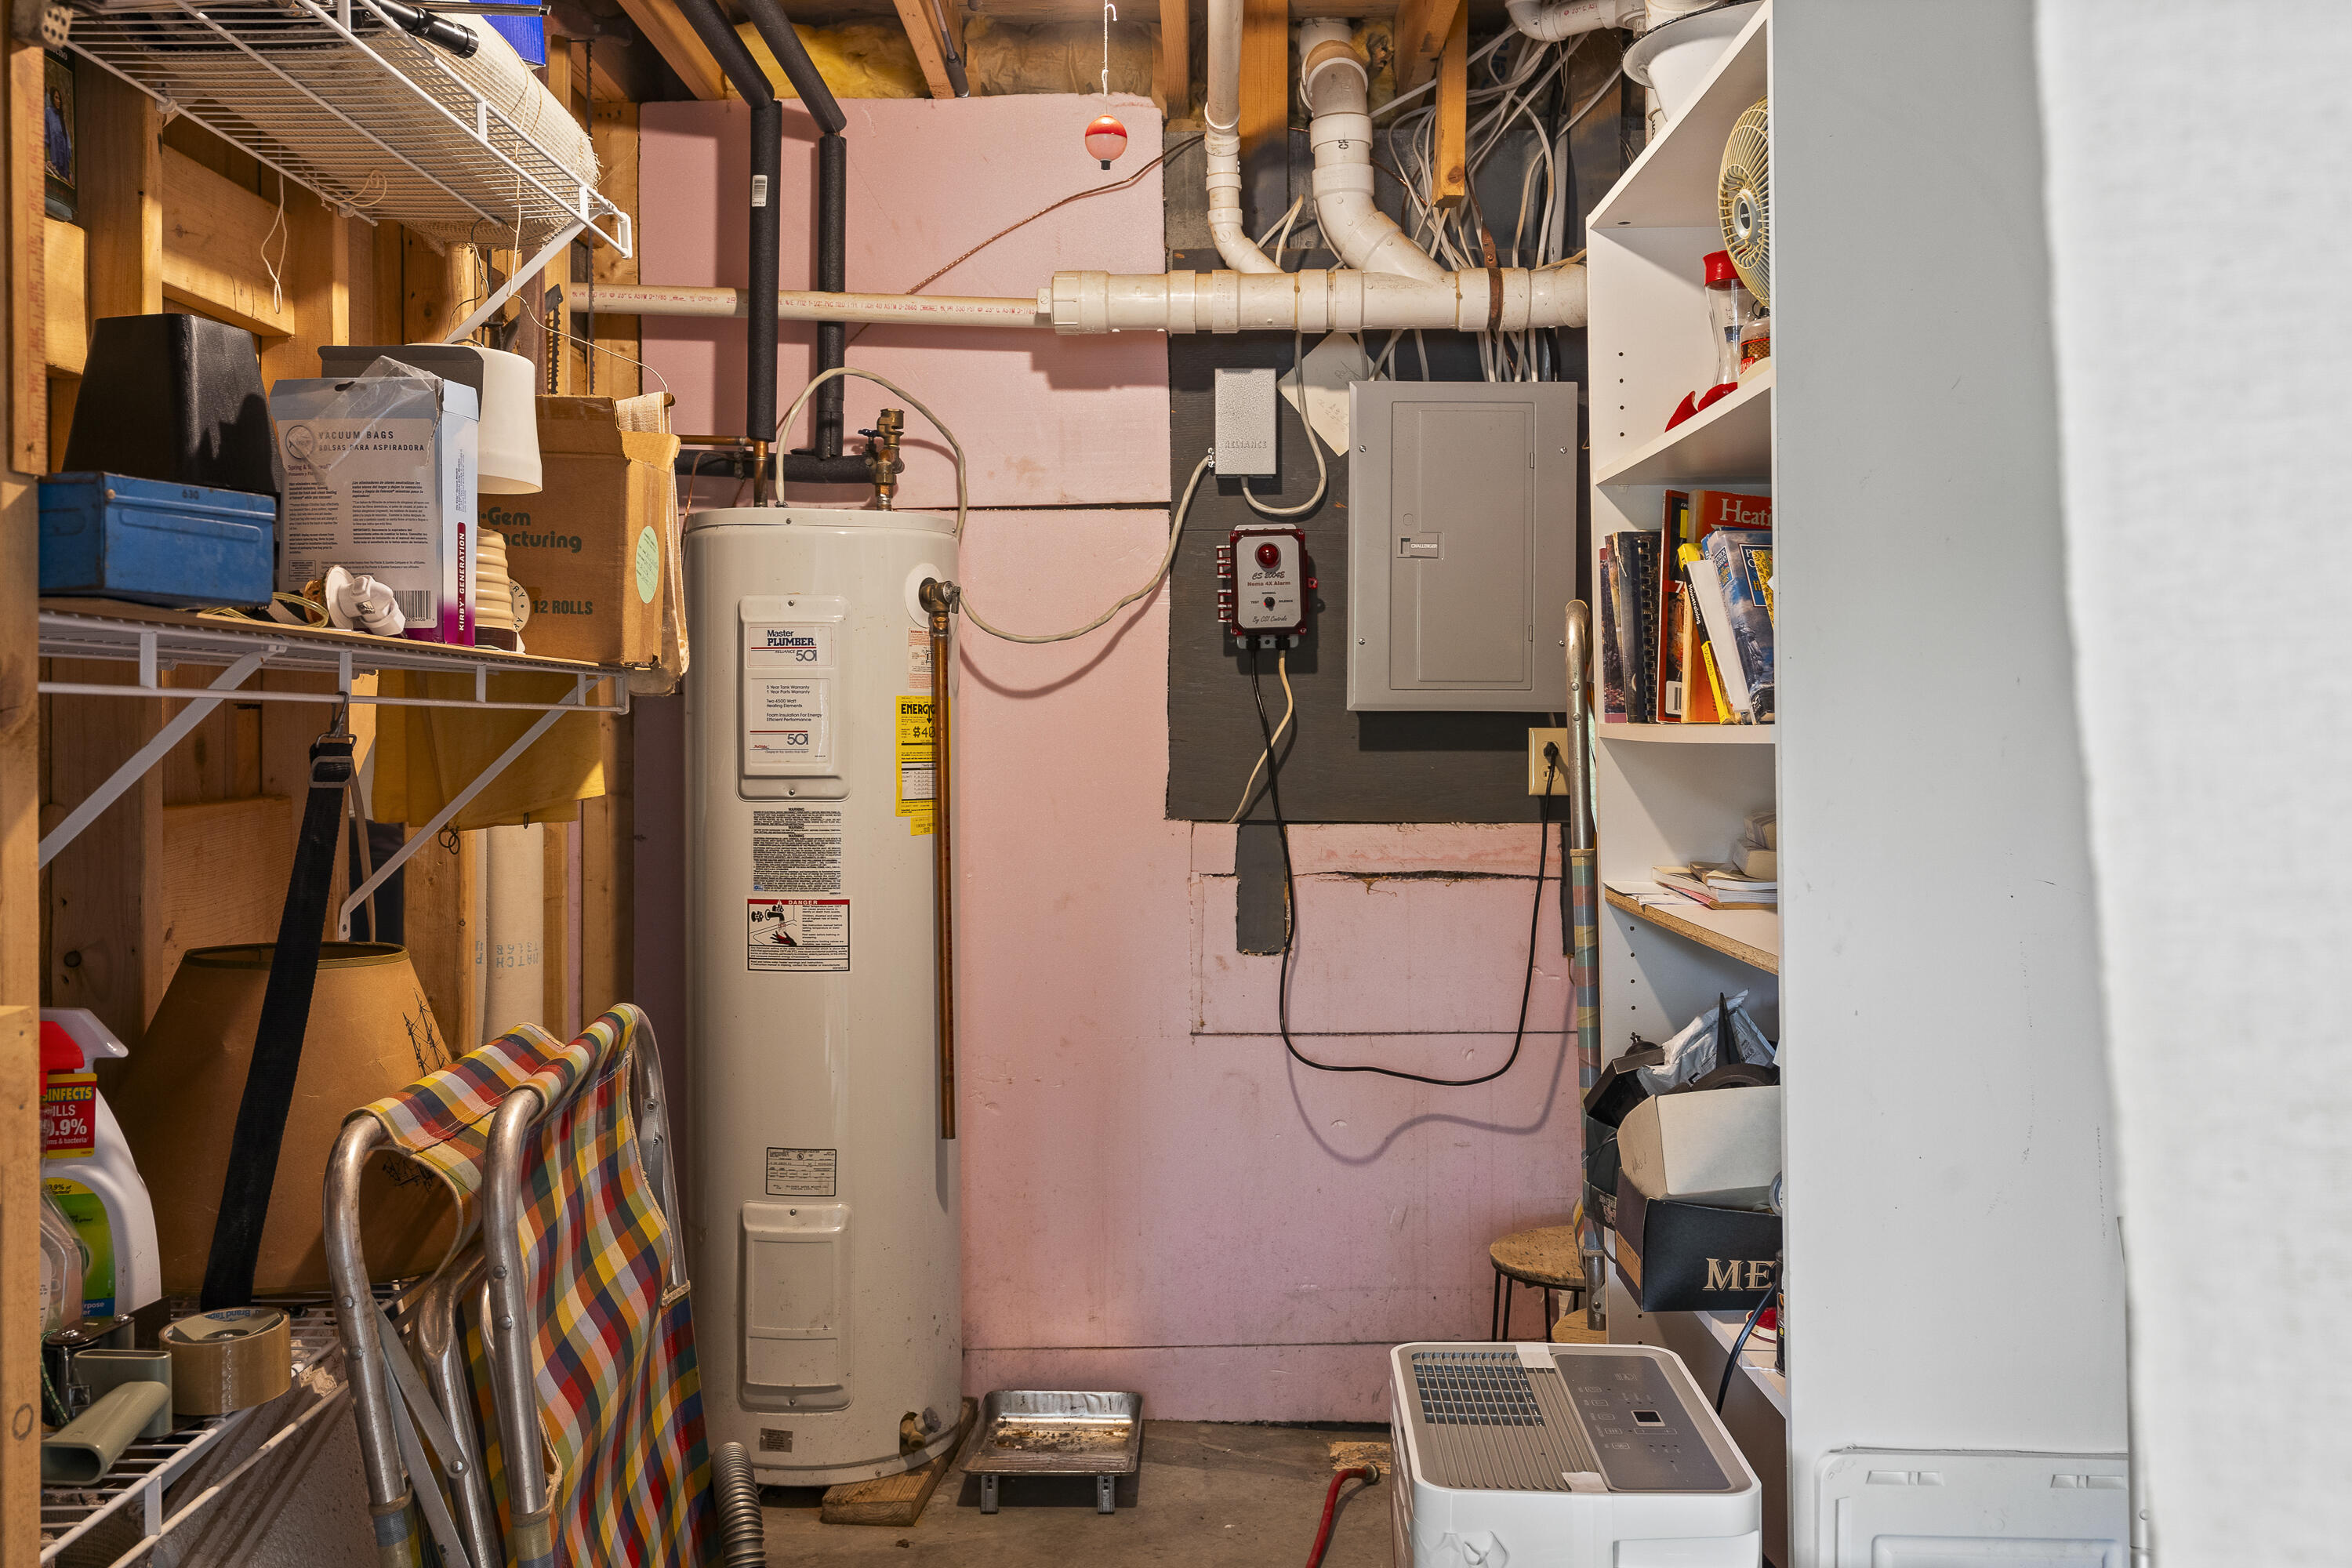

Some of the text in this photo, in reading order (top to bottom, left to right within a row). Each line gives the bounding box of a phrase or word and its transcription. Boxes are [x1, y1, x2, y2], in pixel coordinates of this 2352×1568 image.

[319, 430, 394, 439] VACUUM BAGS
[1224, 440, 1267, 448] RELIANCE
[1720, 498, 1772, 527] Heati
[1264, 571, 1285, 579] 2004E
[533, 600, 593, 615] 12 ROLLS
[1688, 584, 1701, 625] Housetraining
[795, 649, 817, 662] 501
[787, 733, 809, 745] 501
[43, 1086, 93, 1102] SINFECTS
[1702, 1257, 1776, 1292] ME
